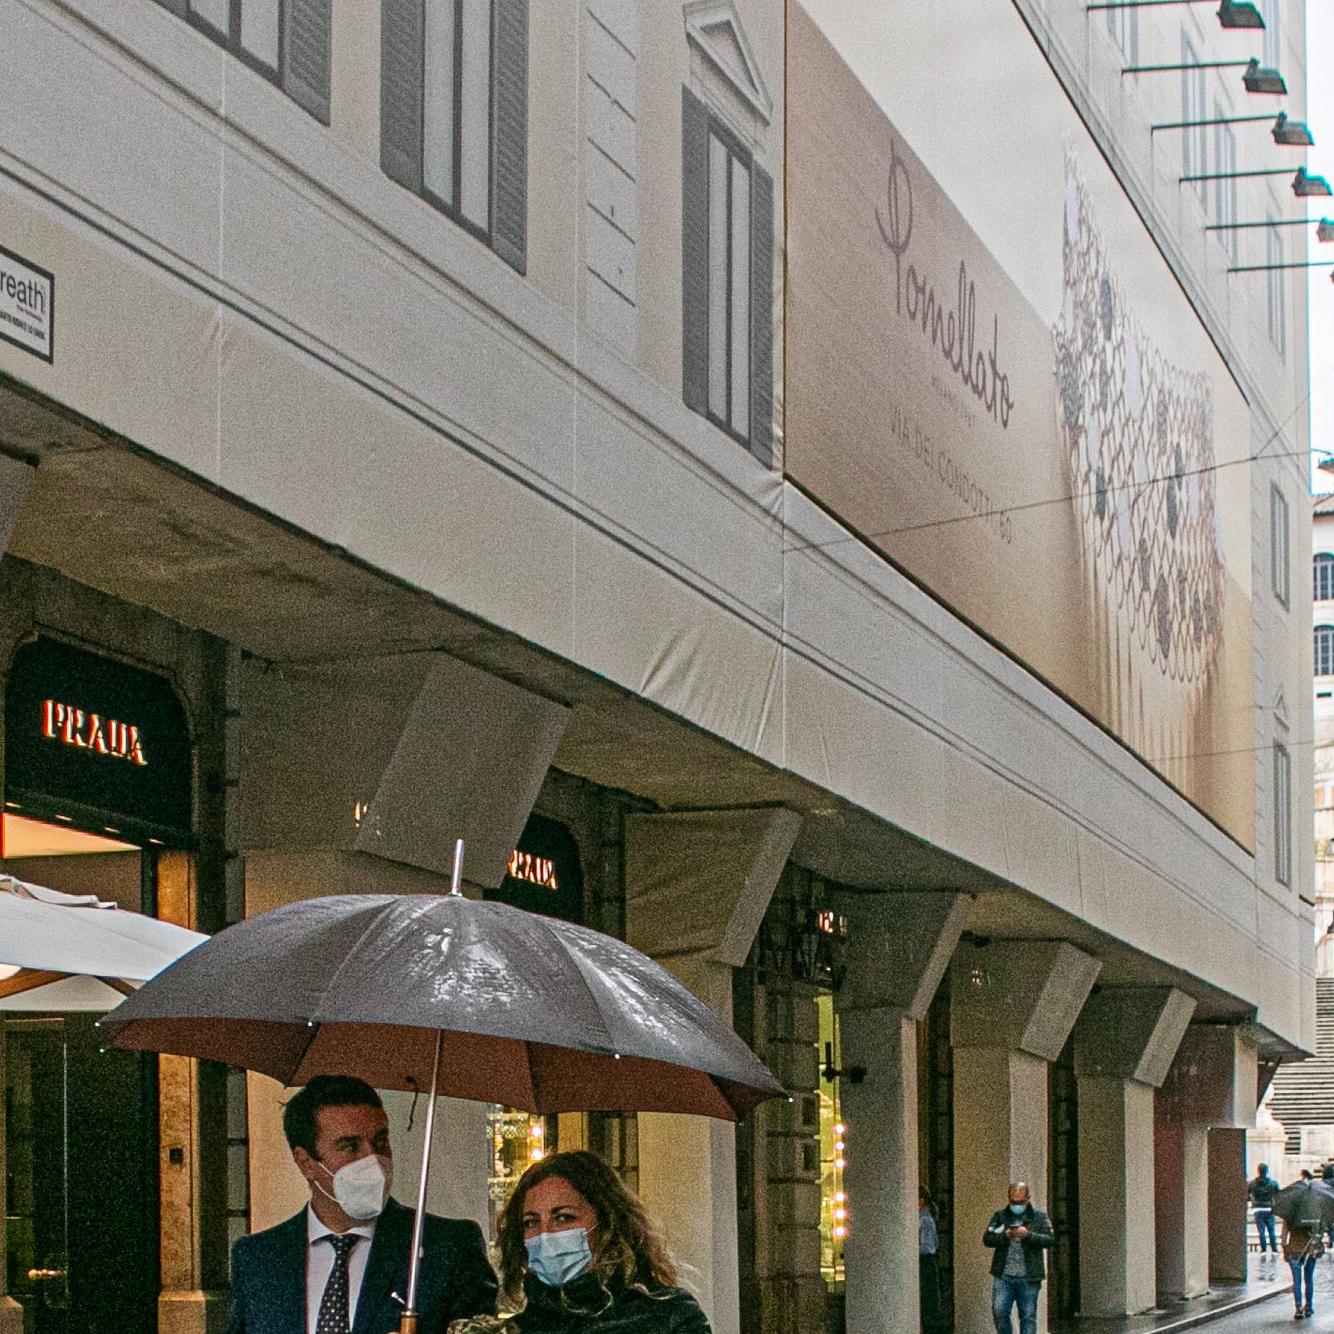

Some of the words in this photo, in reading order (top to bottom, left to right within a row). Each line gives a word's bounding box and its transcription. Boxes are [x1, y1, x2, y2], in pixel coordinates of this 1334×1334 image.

[875, 139, 1015, 429] Pomellato
[916, 428, 934, 470] DEI
[938, 452, 994, 524] CONDOTTI
[43, 699, 147, 766] PRADA
[508, 849, 558, 890] RADA
